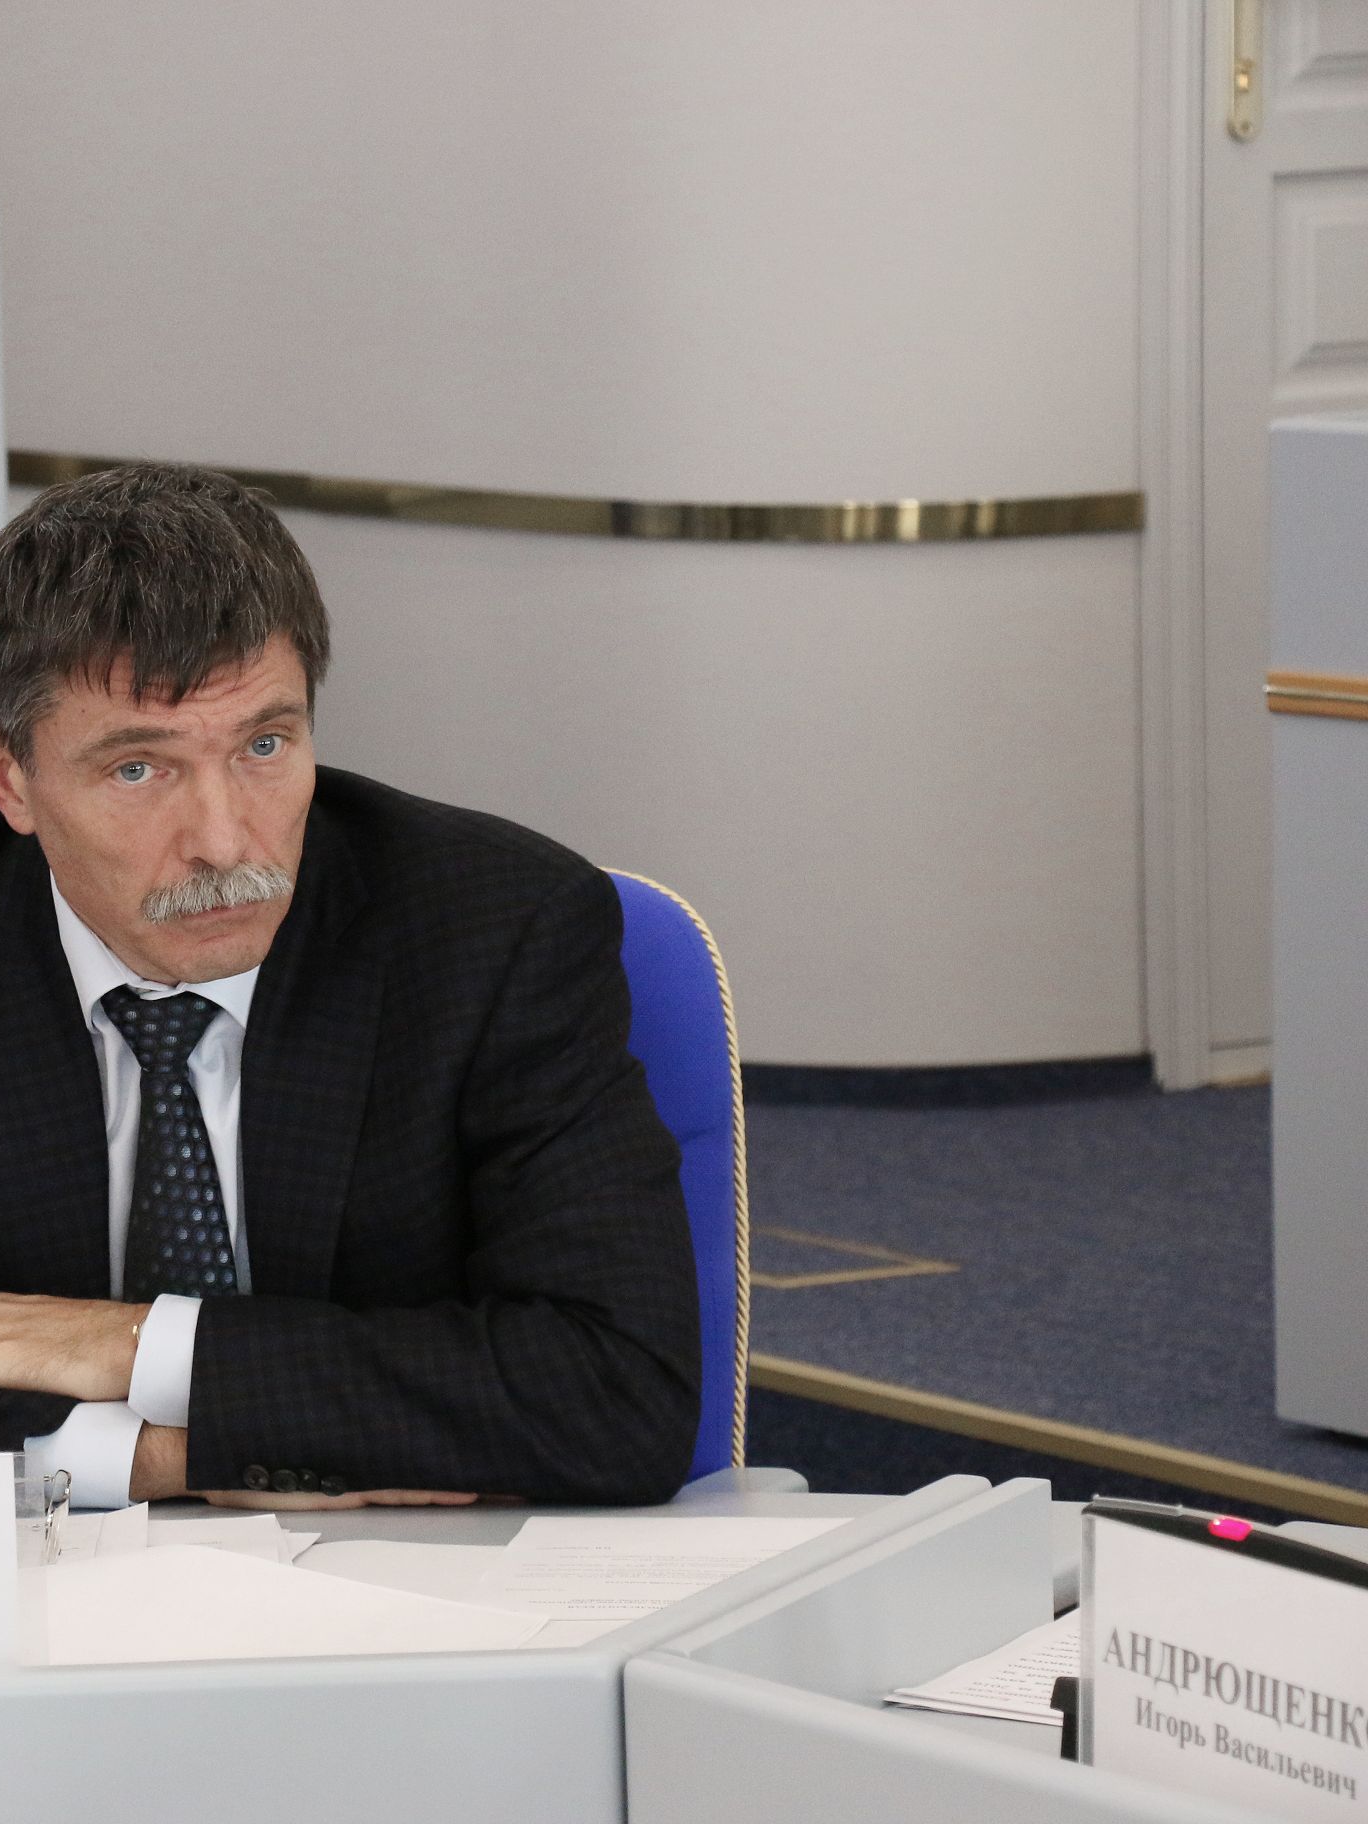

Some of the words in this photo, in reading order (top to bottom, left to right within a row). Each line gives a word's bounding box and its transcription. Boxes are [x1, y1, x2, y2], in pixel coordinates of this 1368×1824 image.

[1102, 1626, 1368, 1750] АНДРЮЩЕНК
[1134, 1696, 1207, 1750] Игорь
[1214, 1722, 1357, 1802] Васильевич
